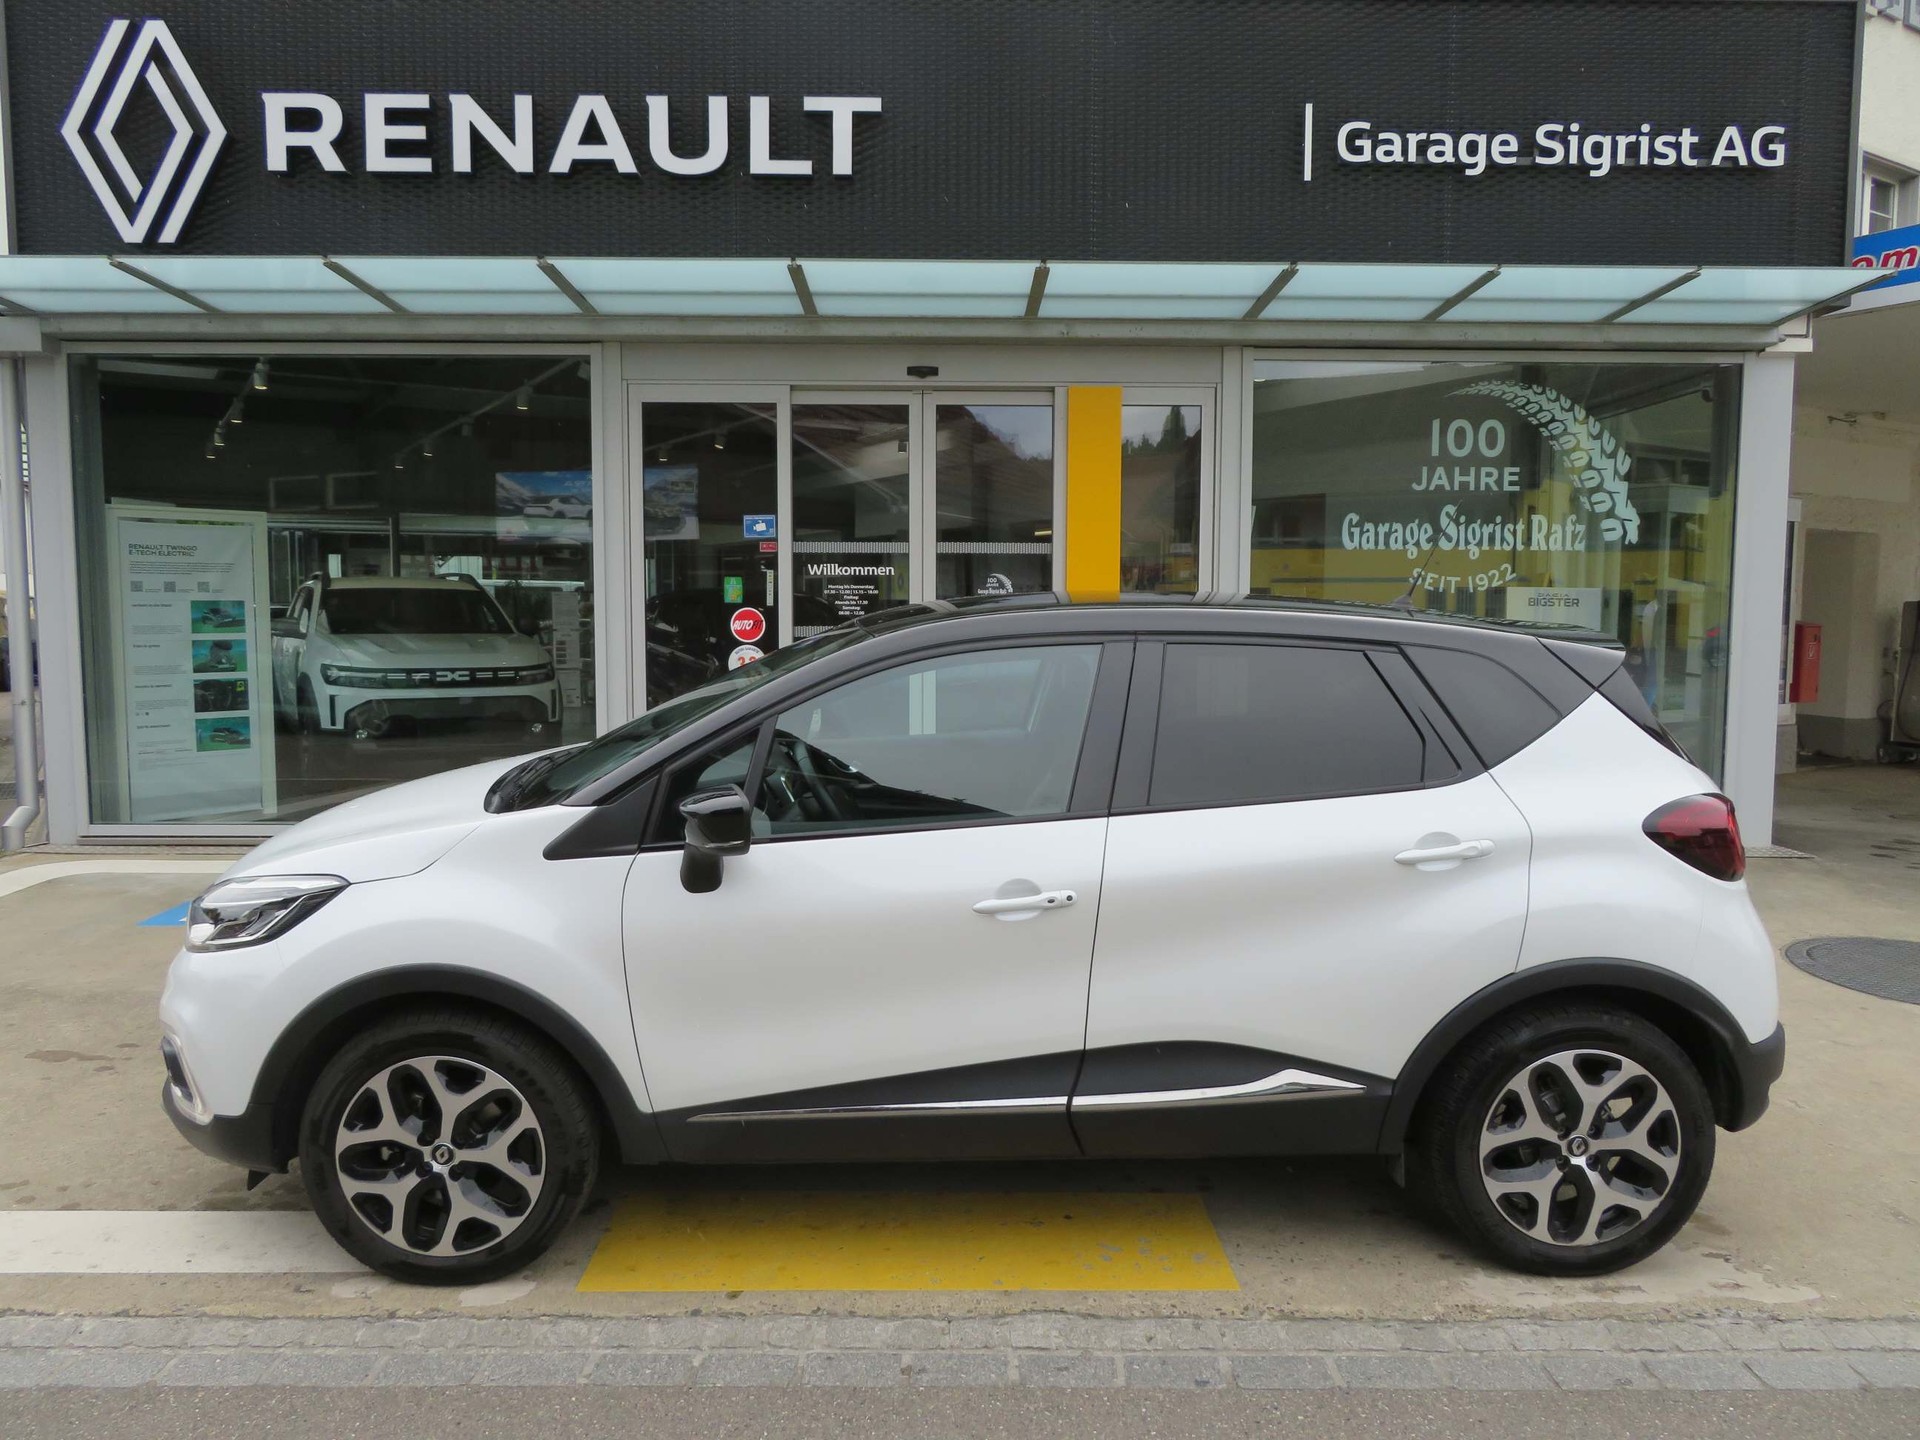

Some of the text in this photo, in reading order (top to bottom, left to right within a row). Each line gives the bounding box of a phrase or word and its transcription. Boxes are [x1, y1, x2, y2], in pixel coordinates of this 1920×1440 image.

[261, 92, 882, 176] RENAULT
[1337, 121, 1787, 177] Garage Sigrist AG
[1430, 418, 1506, 458] 100
[1411, 466, 1521, 492] JAHRE
[128, 543, 164, 551] RENAULT
[1341, 503, 1586, 560] Garage Sigrist Rafz
[807, 563, 895, 576] Willkommen
[1408, 562, 1518, 594] SEIT 1922
[1527, 597, 1580, 607] BIGSTER
